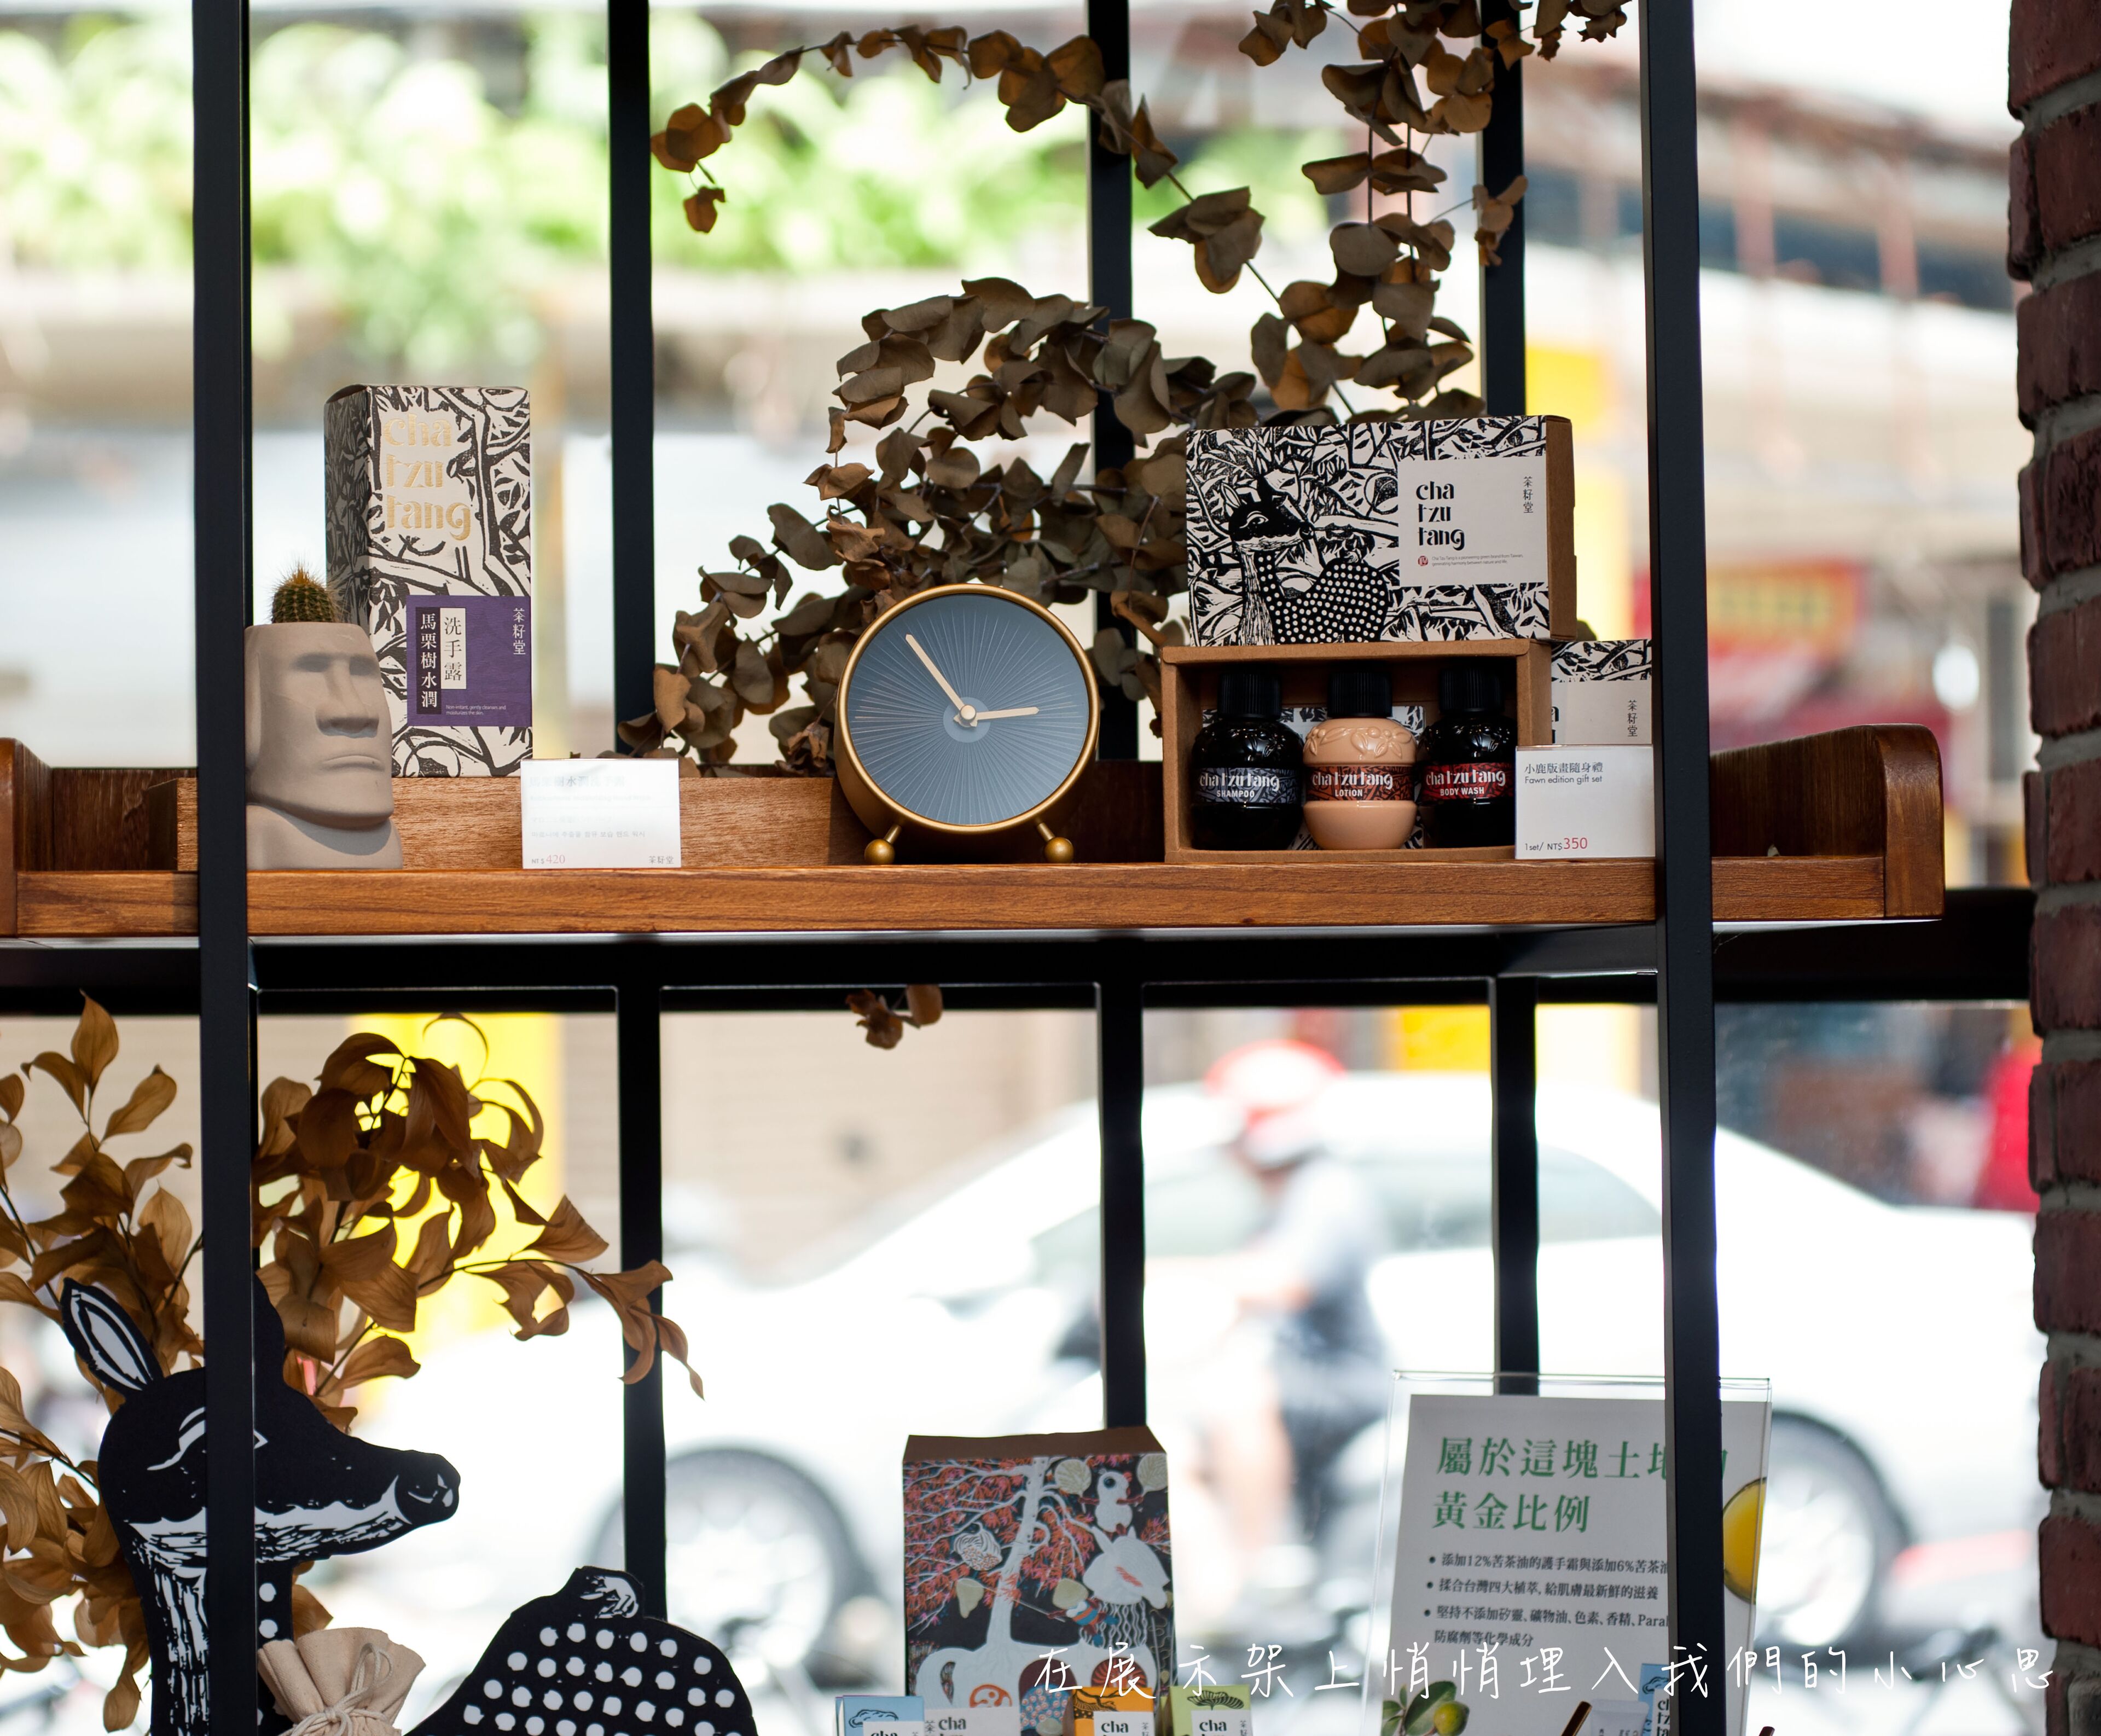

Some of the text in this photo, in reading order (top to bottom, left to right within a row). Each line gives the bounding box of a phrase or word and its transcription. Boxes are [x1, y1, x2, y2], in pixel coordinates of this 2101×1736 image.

[384, 413, 452, 446] cha
[384, 454, 444, 488] tzu
[1416, 481, 1454, 500] cha
[1523, 476, 1534, 513] 茶籽堂
[385, 495, 471, 541] tang
[1417, 503, 1452, 522] tzu
[1418, 527, 1465, 551] tang
[513, 608, 526, 655] 茶籽堂
[444, 617, 462, 681] 洗手露
[421, 613, 437, 707] 馬栗樹水潤
[1627, 700, 1638, 736] 茶籽堂
[1426, 772, 1444, 785] cha
[1472, 769, 1506, 786] tang
[1525, 762, 1603, 774] 小鹿版畫隨身禮
[1200, 773, 1218, 786] cha
[1247, 773, 1280, 792] tang
[1313, 772, 1332, 785] cha
[1361, 771, 1392, 789] tang
[1548, 775, 1574, 783] edition
[1577, 774, 1589, 785] gift
[1440, 787, 1484, 796] BODY WASH
[1432, 1491, 1591, 1534] 黃金比例
[938, 1717, 966, 1731] cha
[1101, 1721, 1129, 1733] cha
[1199, 1720, 1227, 1732] cha
